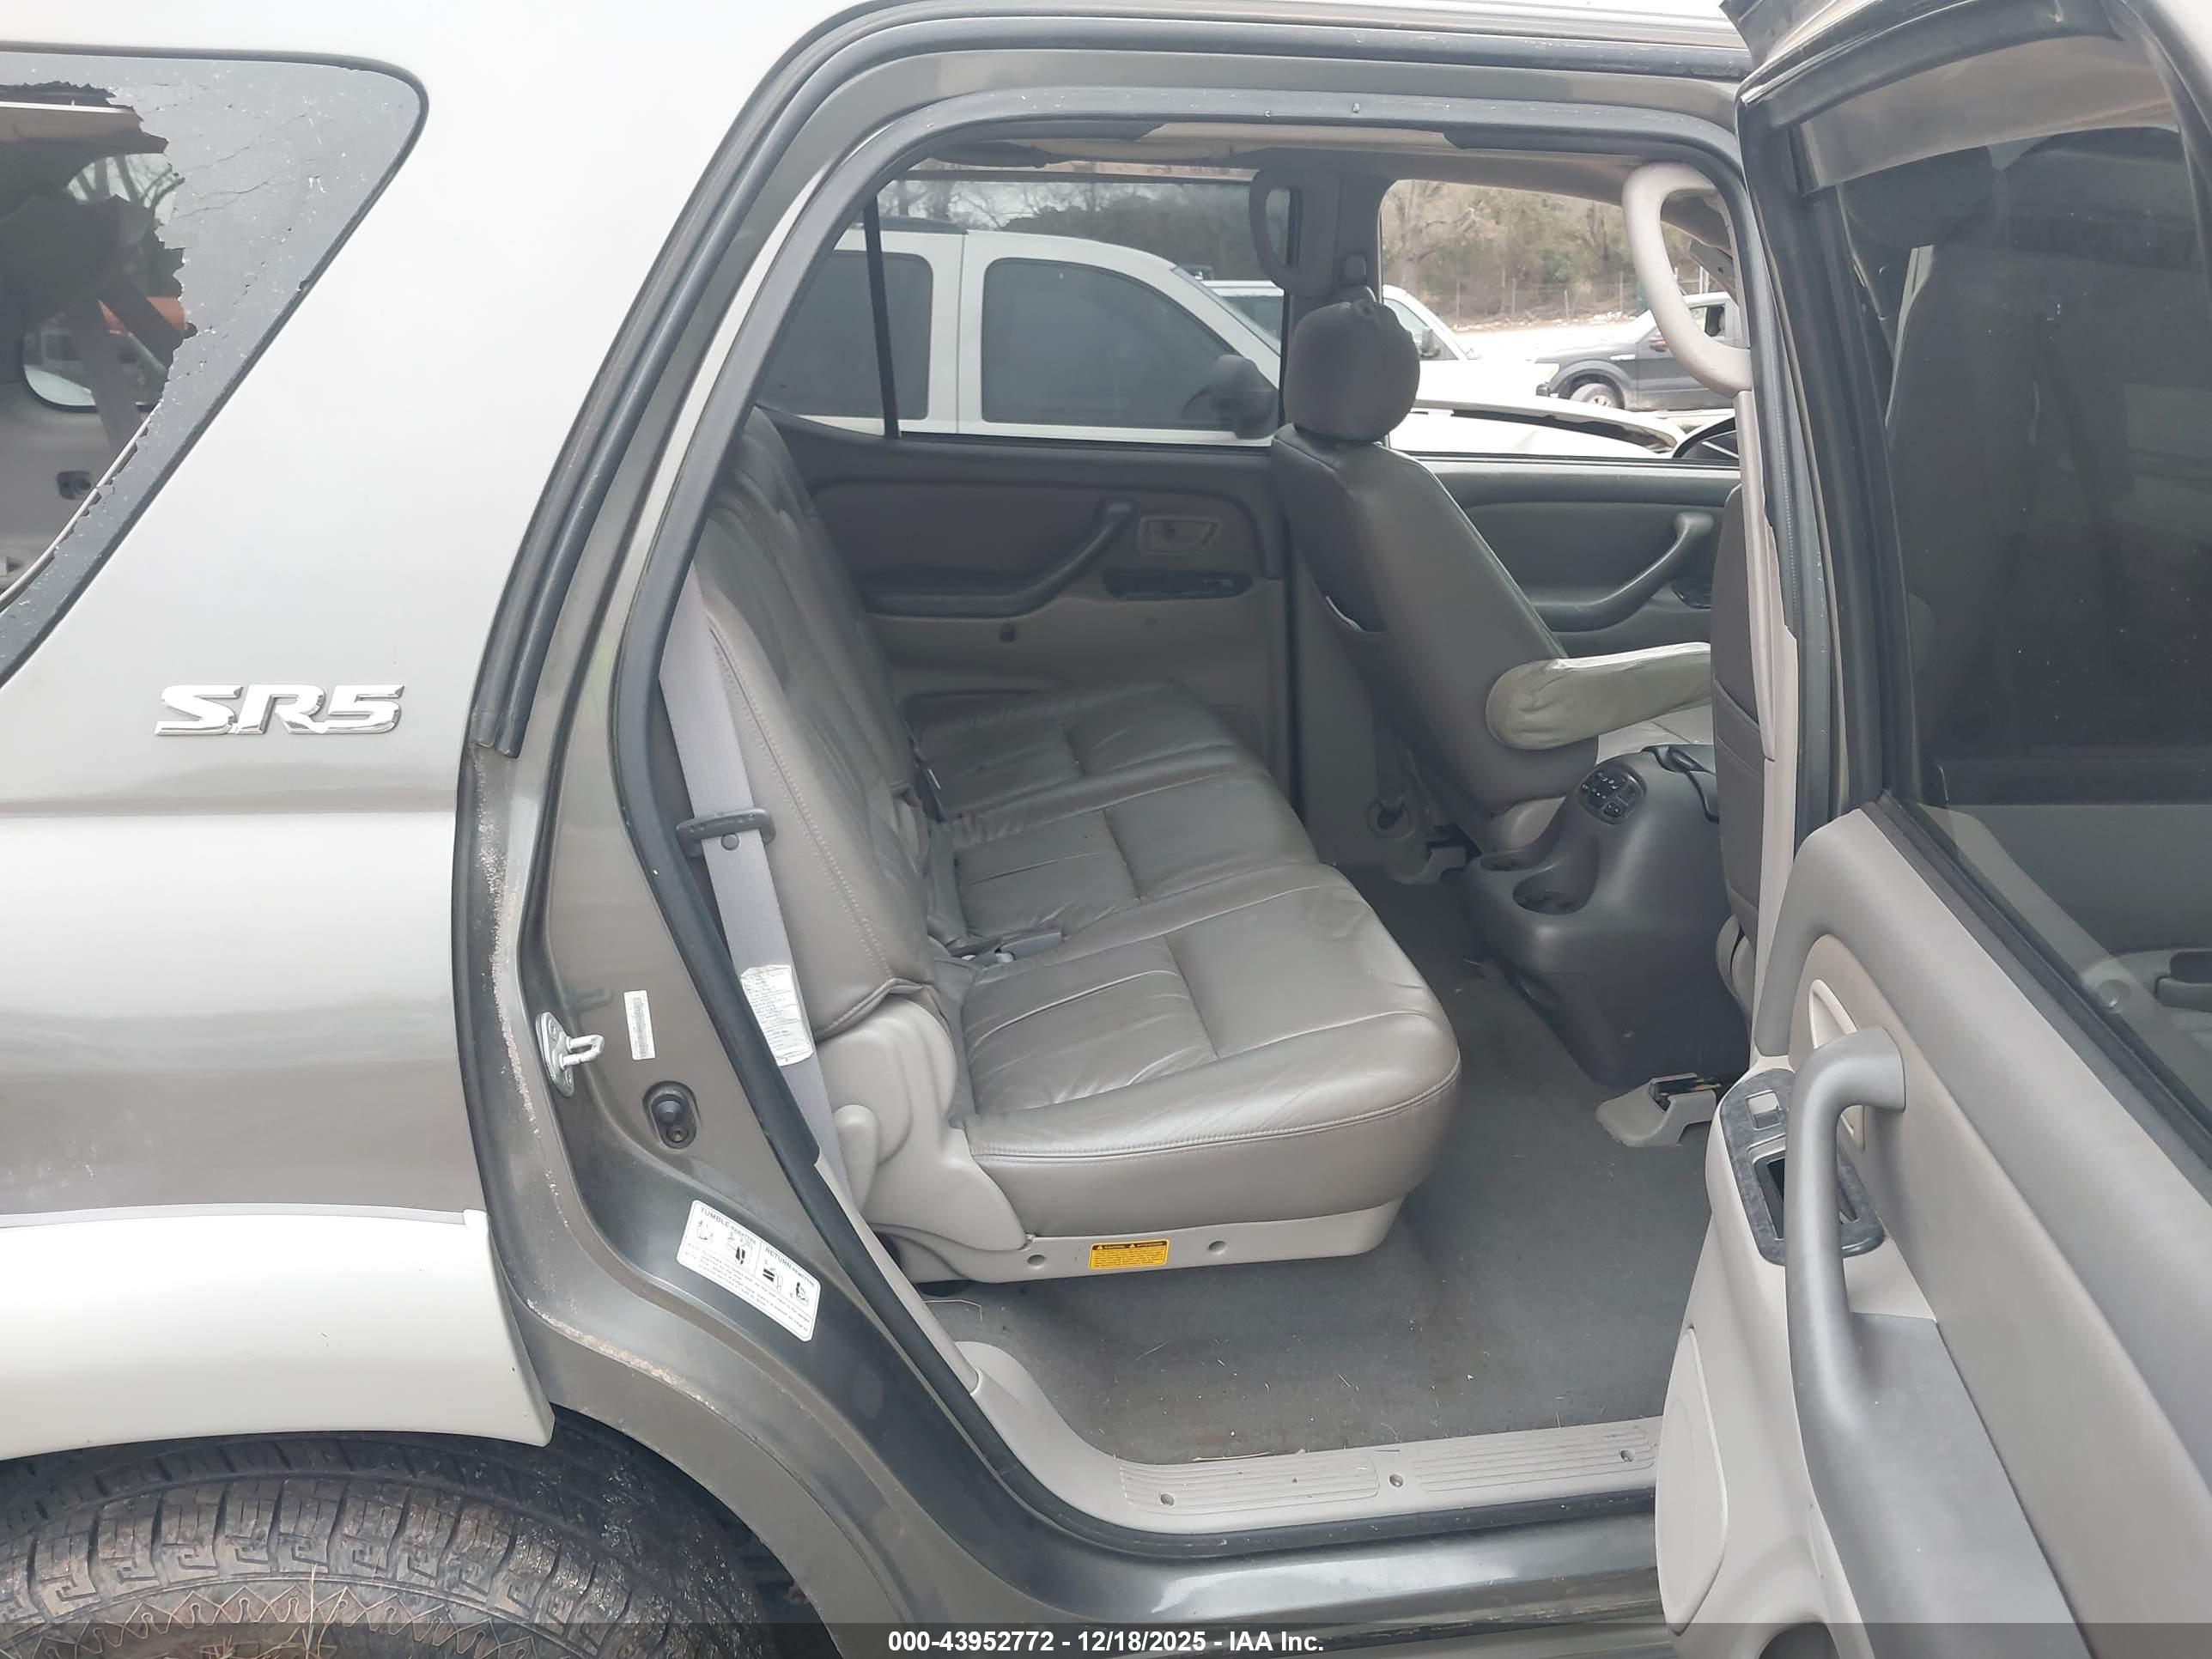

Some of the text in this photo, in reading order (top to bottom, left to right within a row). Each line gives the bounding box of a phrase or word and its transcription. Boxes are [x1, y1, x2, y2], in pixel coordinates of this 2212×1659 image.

[155, 684, 404, 735] SR5
[700, 1206, 730, 1228] TUMBLE
[764, 1247, 792, 1270] RETURN
